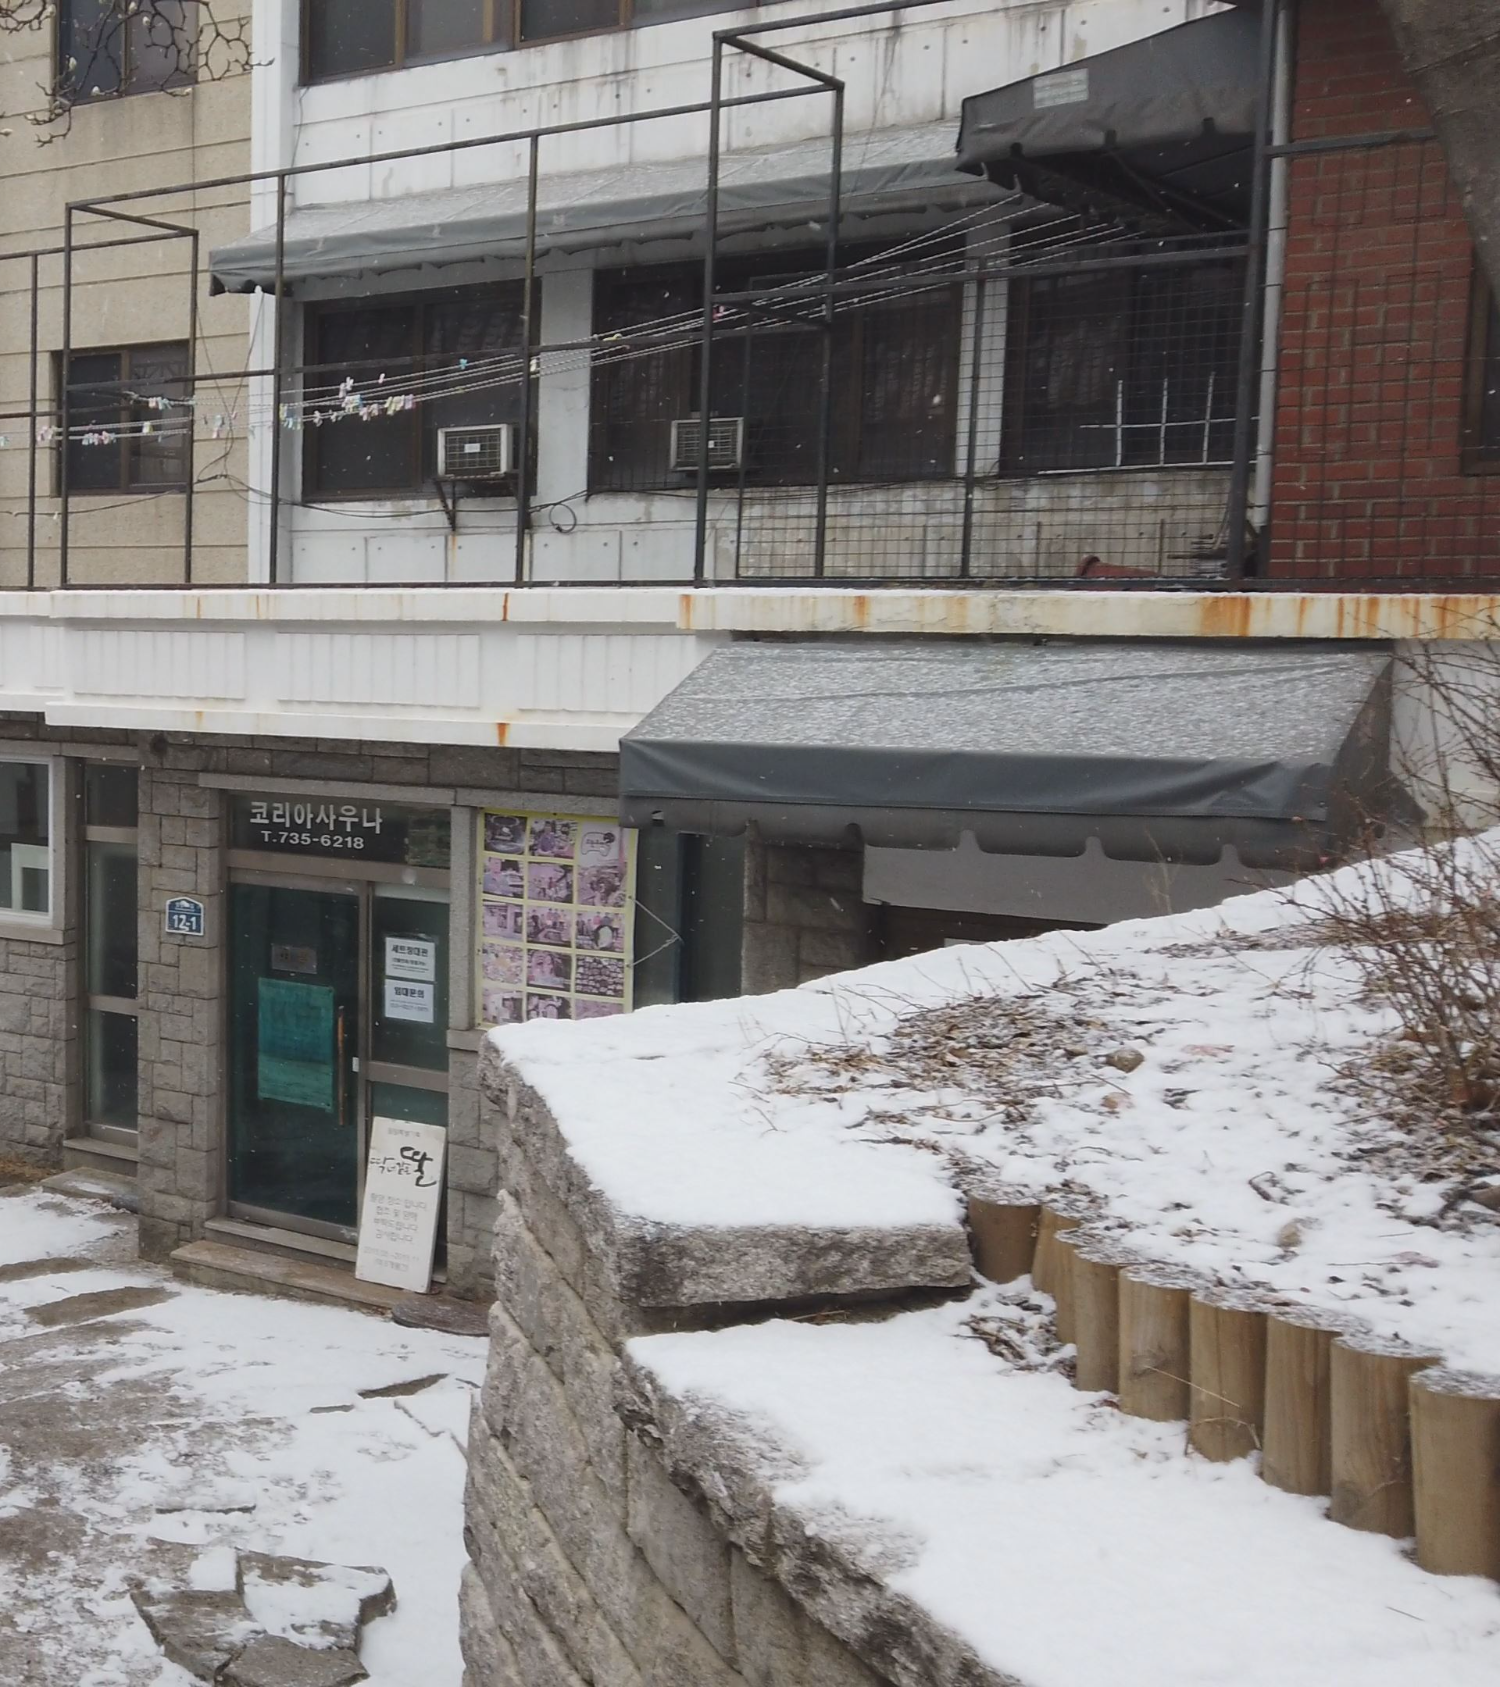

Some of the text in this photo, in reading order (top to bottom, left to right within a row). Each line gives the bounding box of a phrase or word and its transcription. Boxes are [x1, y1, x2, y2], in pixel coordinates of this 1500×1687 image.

[250, 801, 384, 834] 코리아사우나
[260, 830, 365, 849] T.735-6218
[172, 914, 197, 931] 12-1
[400, 1146, 437, 1187] 딸
